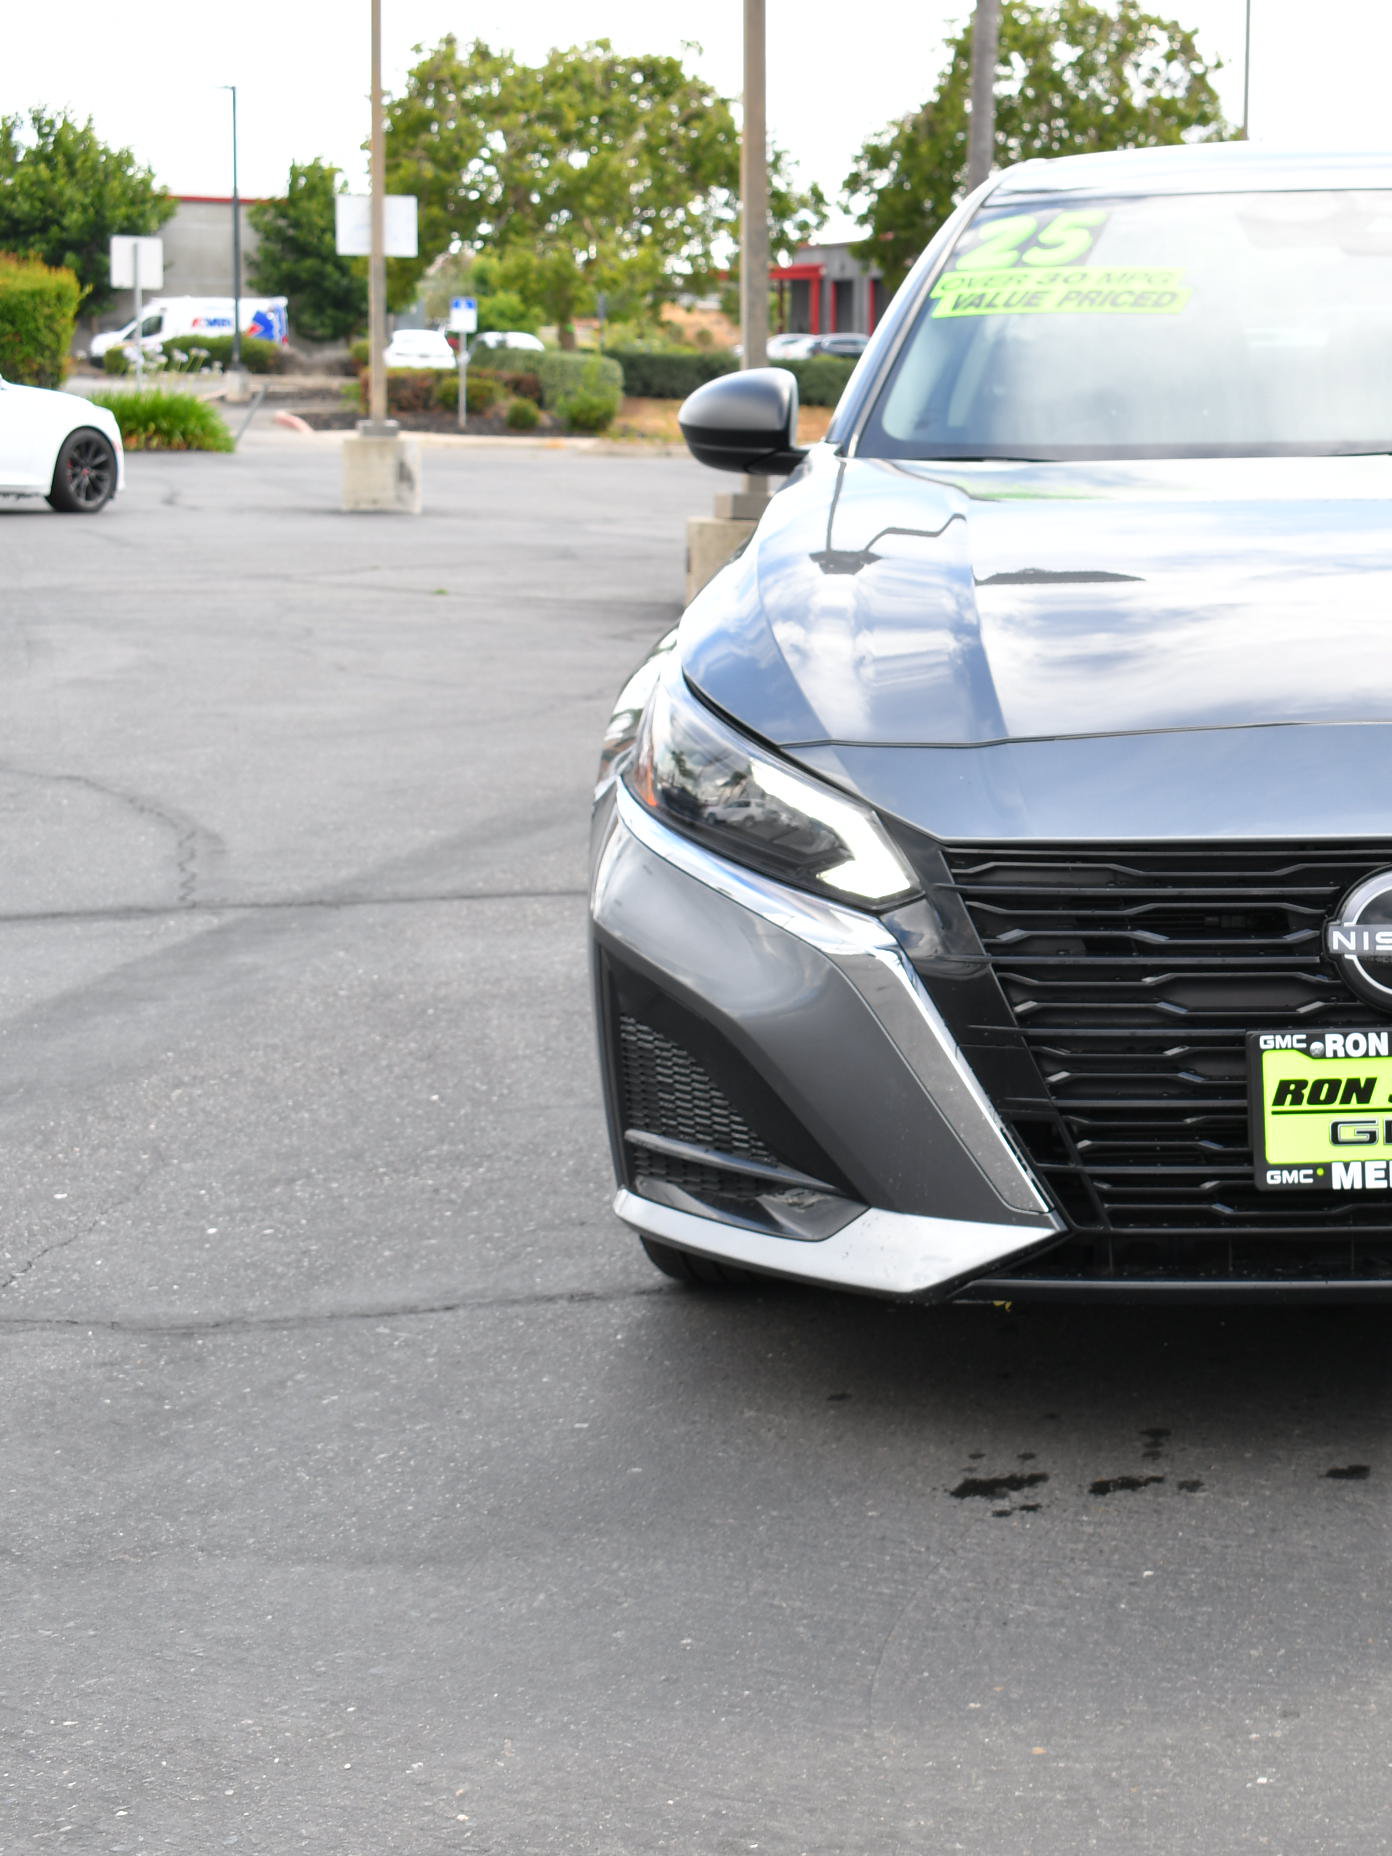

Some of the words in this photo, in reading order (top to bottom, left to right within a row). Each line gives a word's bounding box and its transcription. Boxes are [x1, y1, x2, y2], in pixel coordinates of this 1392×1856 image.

[956, 209, 1109, 271] 25
[1036, 272, 1088, 285] 30
[951, 291, 1050, 312] VALUE
[1057, 290, 1179, 308] PRICED
[1259, 1034, 1307, 1050] GMC
[1324, 1032, 1389, 1058] RON
[1271, 1076, 1378, 1107] RON
[1266, 1168, 1314, 1185] GMC
